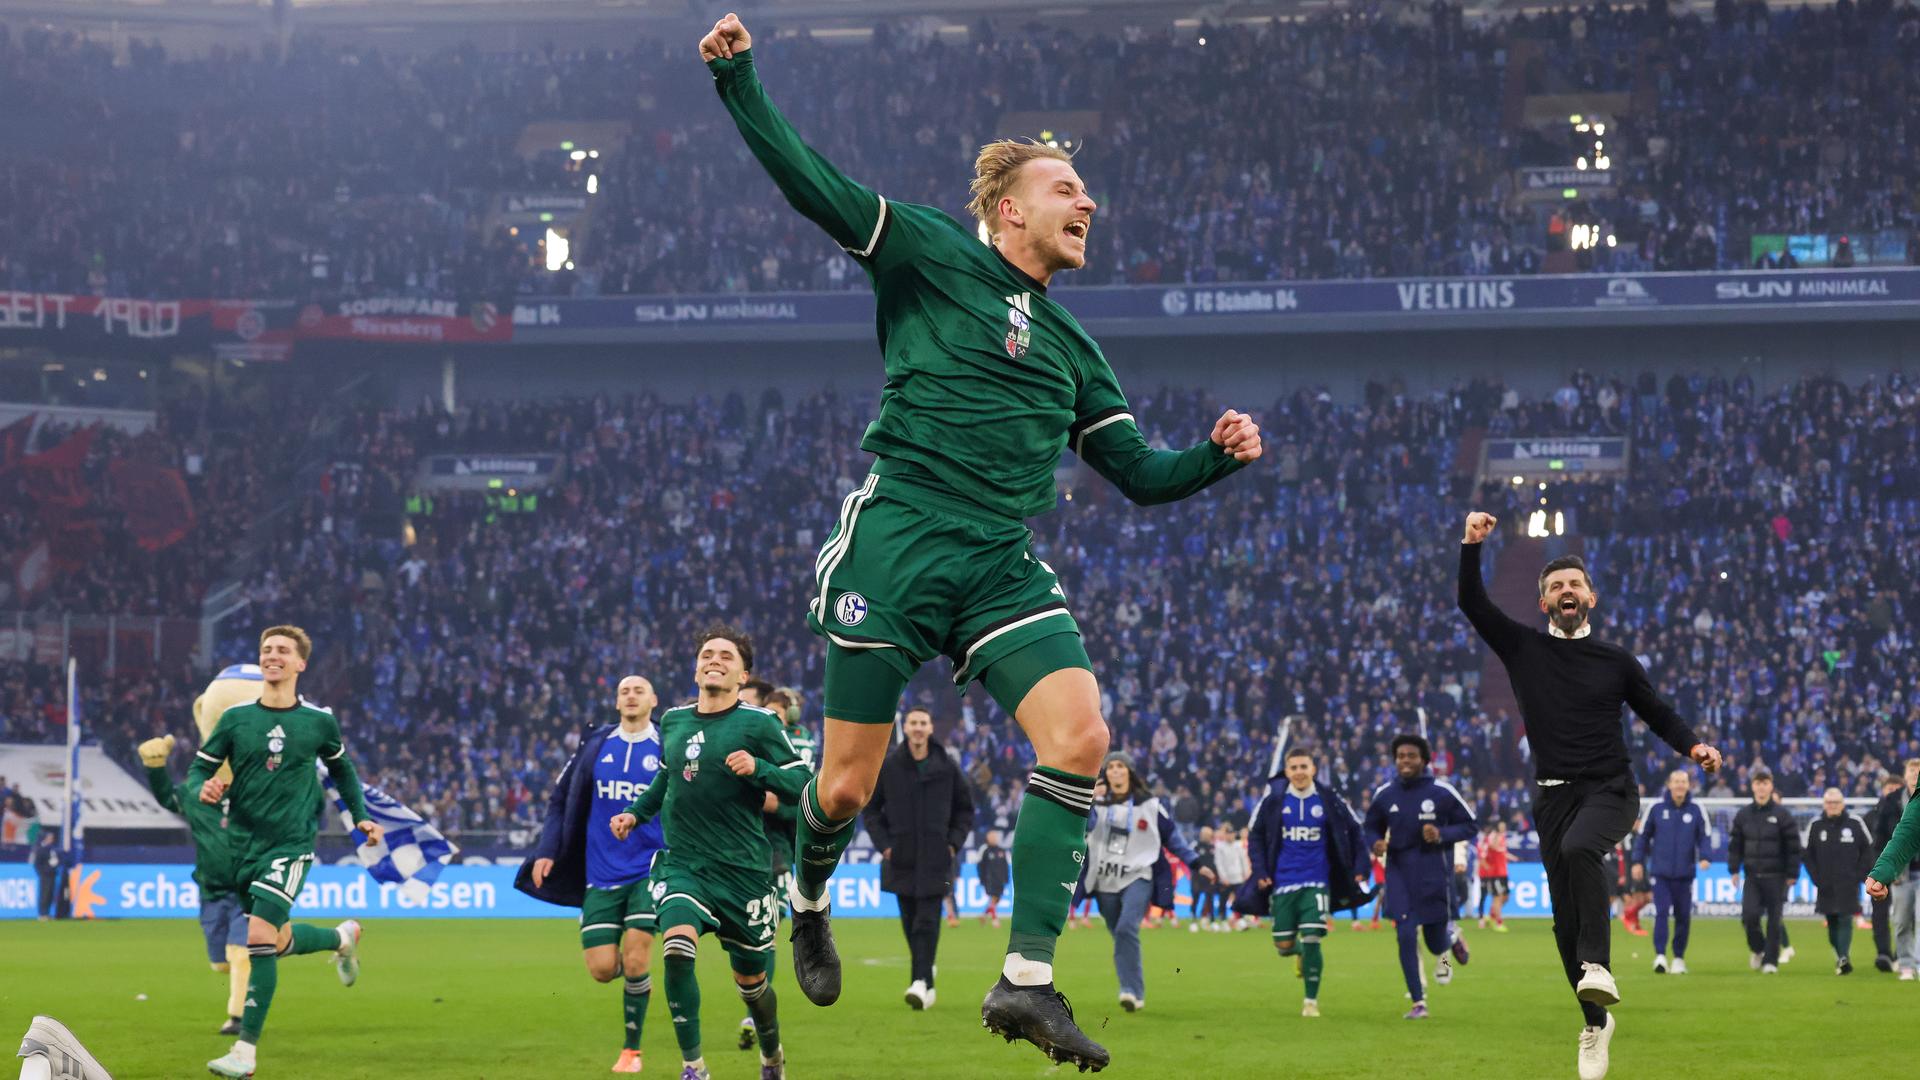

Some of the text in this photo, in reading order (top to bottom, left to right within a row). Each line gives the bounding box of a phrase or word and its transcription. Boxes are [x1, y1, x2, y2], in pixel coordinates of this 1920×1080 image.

[1399, 281, 1515, 310] VELTINS
[1716, 278, 1889, 299] SUN MINIMEAL
[94, 298, 180, 338] 1900
[635, 302, 797, 321] SUN MINIMEAL
[1282, 826, 1321, 841] HRS
[380, 881, 496, 909] resen
[746, 898, 774, 928] 23
